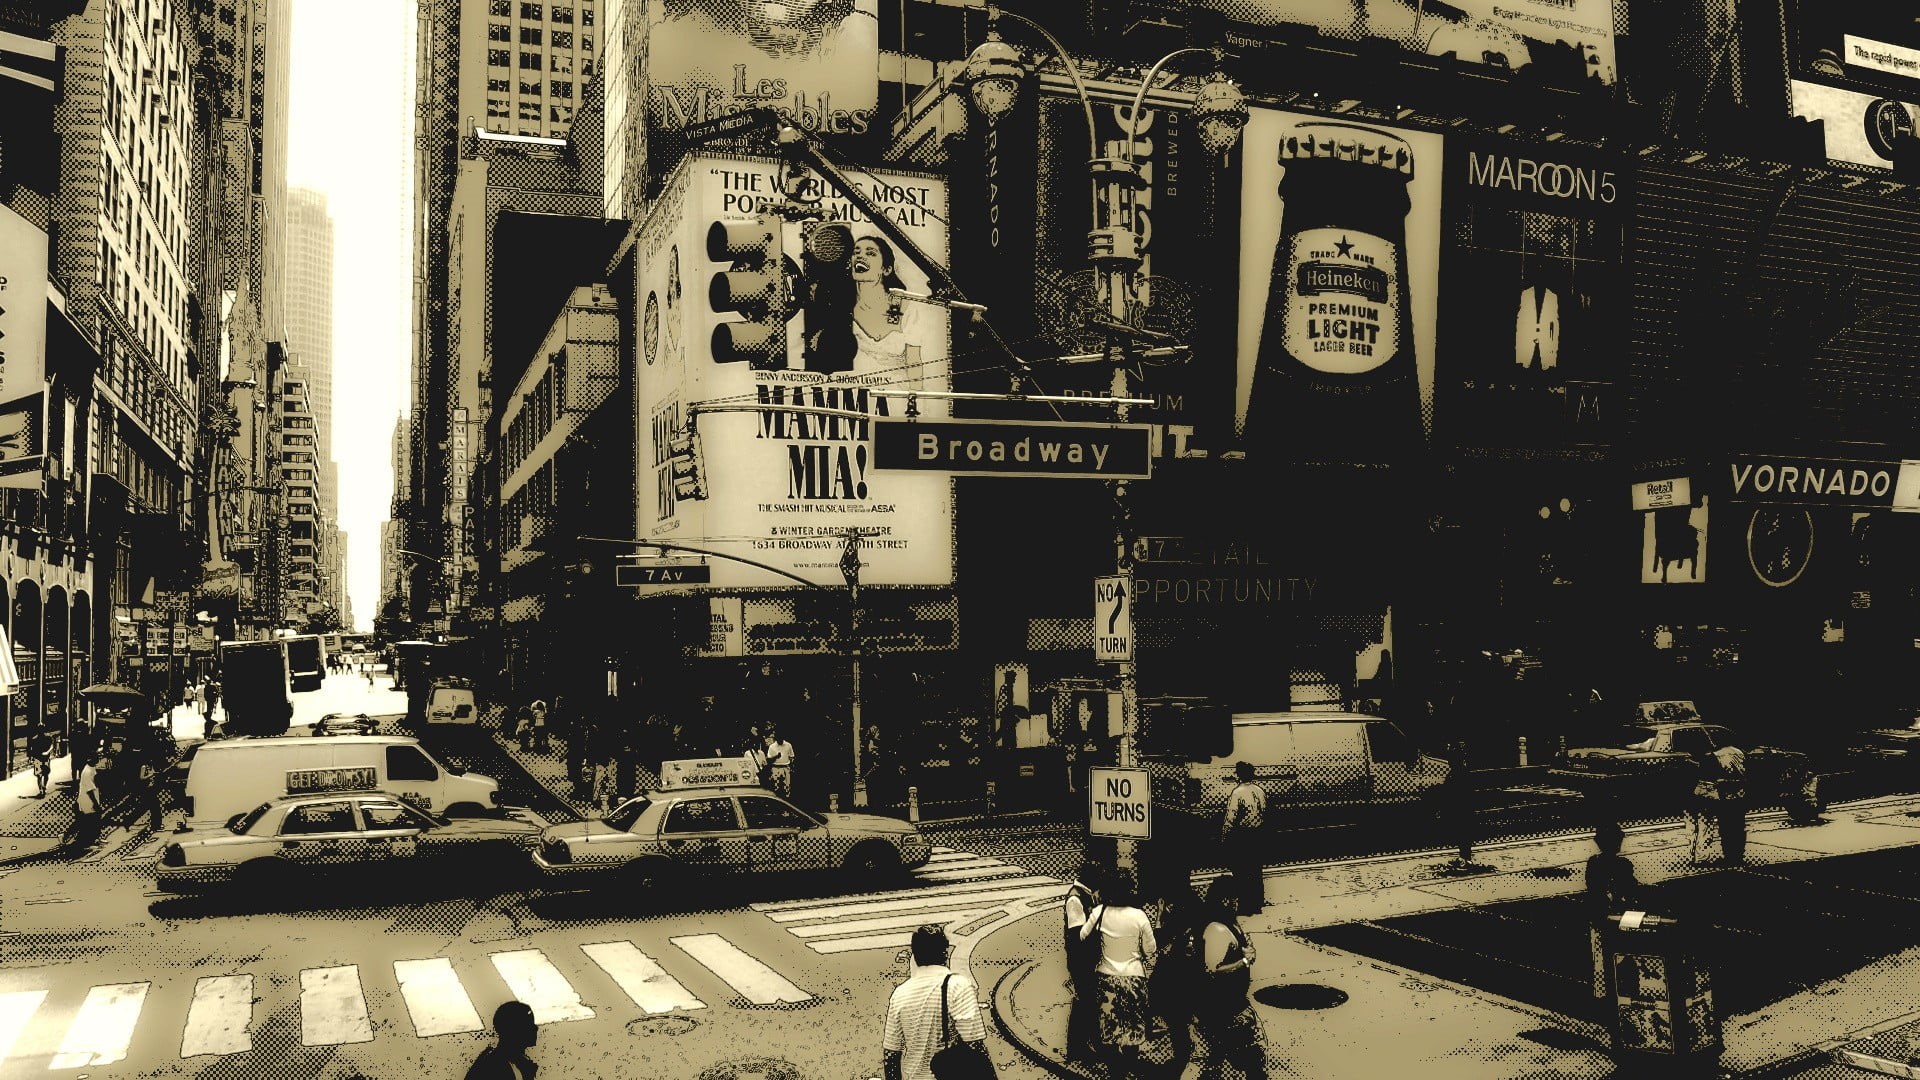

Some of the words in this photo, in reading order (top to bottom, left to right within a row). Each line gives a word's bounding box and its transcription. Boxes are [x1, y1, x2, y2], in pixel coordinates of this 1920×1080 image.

[1854, 45, 1870, 60] The
[1871, 51, 1892, 66] rapid
[733, 64, 787, 99] Les
[686, 125, 717, 140] VISTA
[719, 114, 754, 132] MEDIA
[1167, 111, 1178, 196] BREWED
[1468, 151, 1596, 201] MAROON
[1600, 172, 1616, 203] 5
[872, 184, 930, 206] MOST
[1310, 250, 1336, 259] TRADE
[1353, 253, 1375, 265] MARK
[1306, 270, 1380, 293] Heineken
[1308, 303, 1379, 322] PREMIUM
[1308, 318, 1380, 344] LIGHT
[1314, 341, 1346, 353] LAGER
[1349, 343, 1373, 357] BEER
[455, 425, 466, 498] MARAIS
[917, 433, 1110, 470] Broadway
[786, 444, 868, 500] MIA!
[1731, 463, 1891, 497] VORNADO
[1647, 481, 1674, 496] Retail
[774, 504, 800, 513] SMASH
[800, 504, 814, 513] HIT
[815, 505, 847, 514] MUSICAL
[464, 506, 475, 554] PARK
[780, 526, 814, 536] WINTER
[752, 540, 775, 550] 1634
[779, 540, 833, 550] BROADWAY
[836, 540, 846, 550] AT
[876, 540, 909, 550] STREET
[645, 569, 655, 581] 7
[661, 569, 683, 581] Av
[1097, 583, 1114, 603] NO
[1135, 578, 1318, 603] PPORTUNITY
[1099, 636, 1127, 654] TURN
[1106, 778, 1132, 799] NO
[1094, 801, 1146, 823] TURNS
